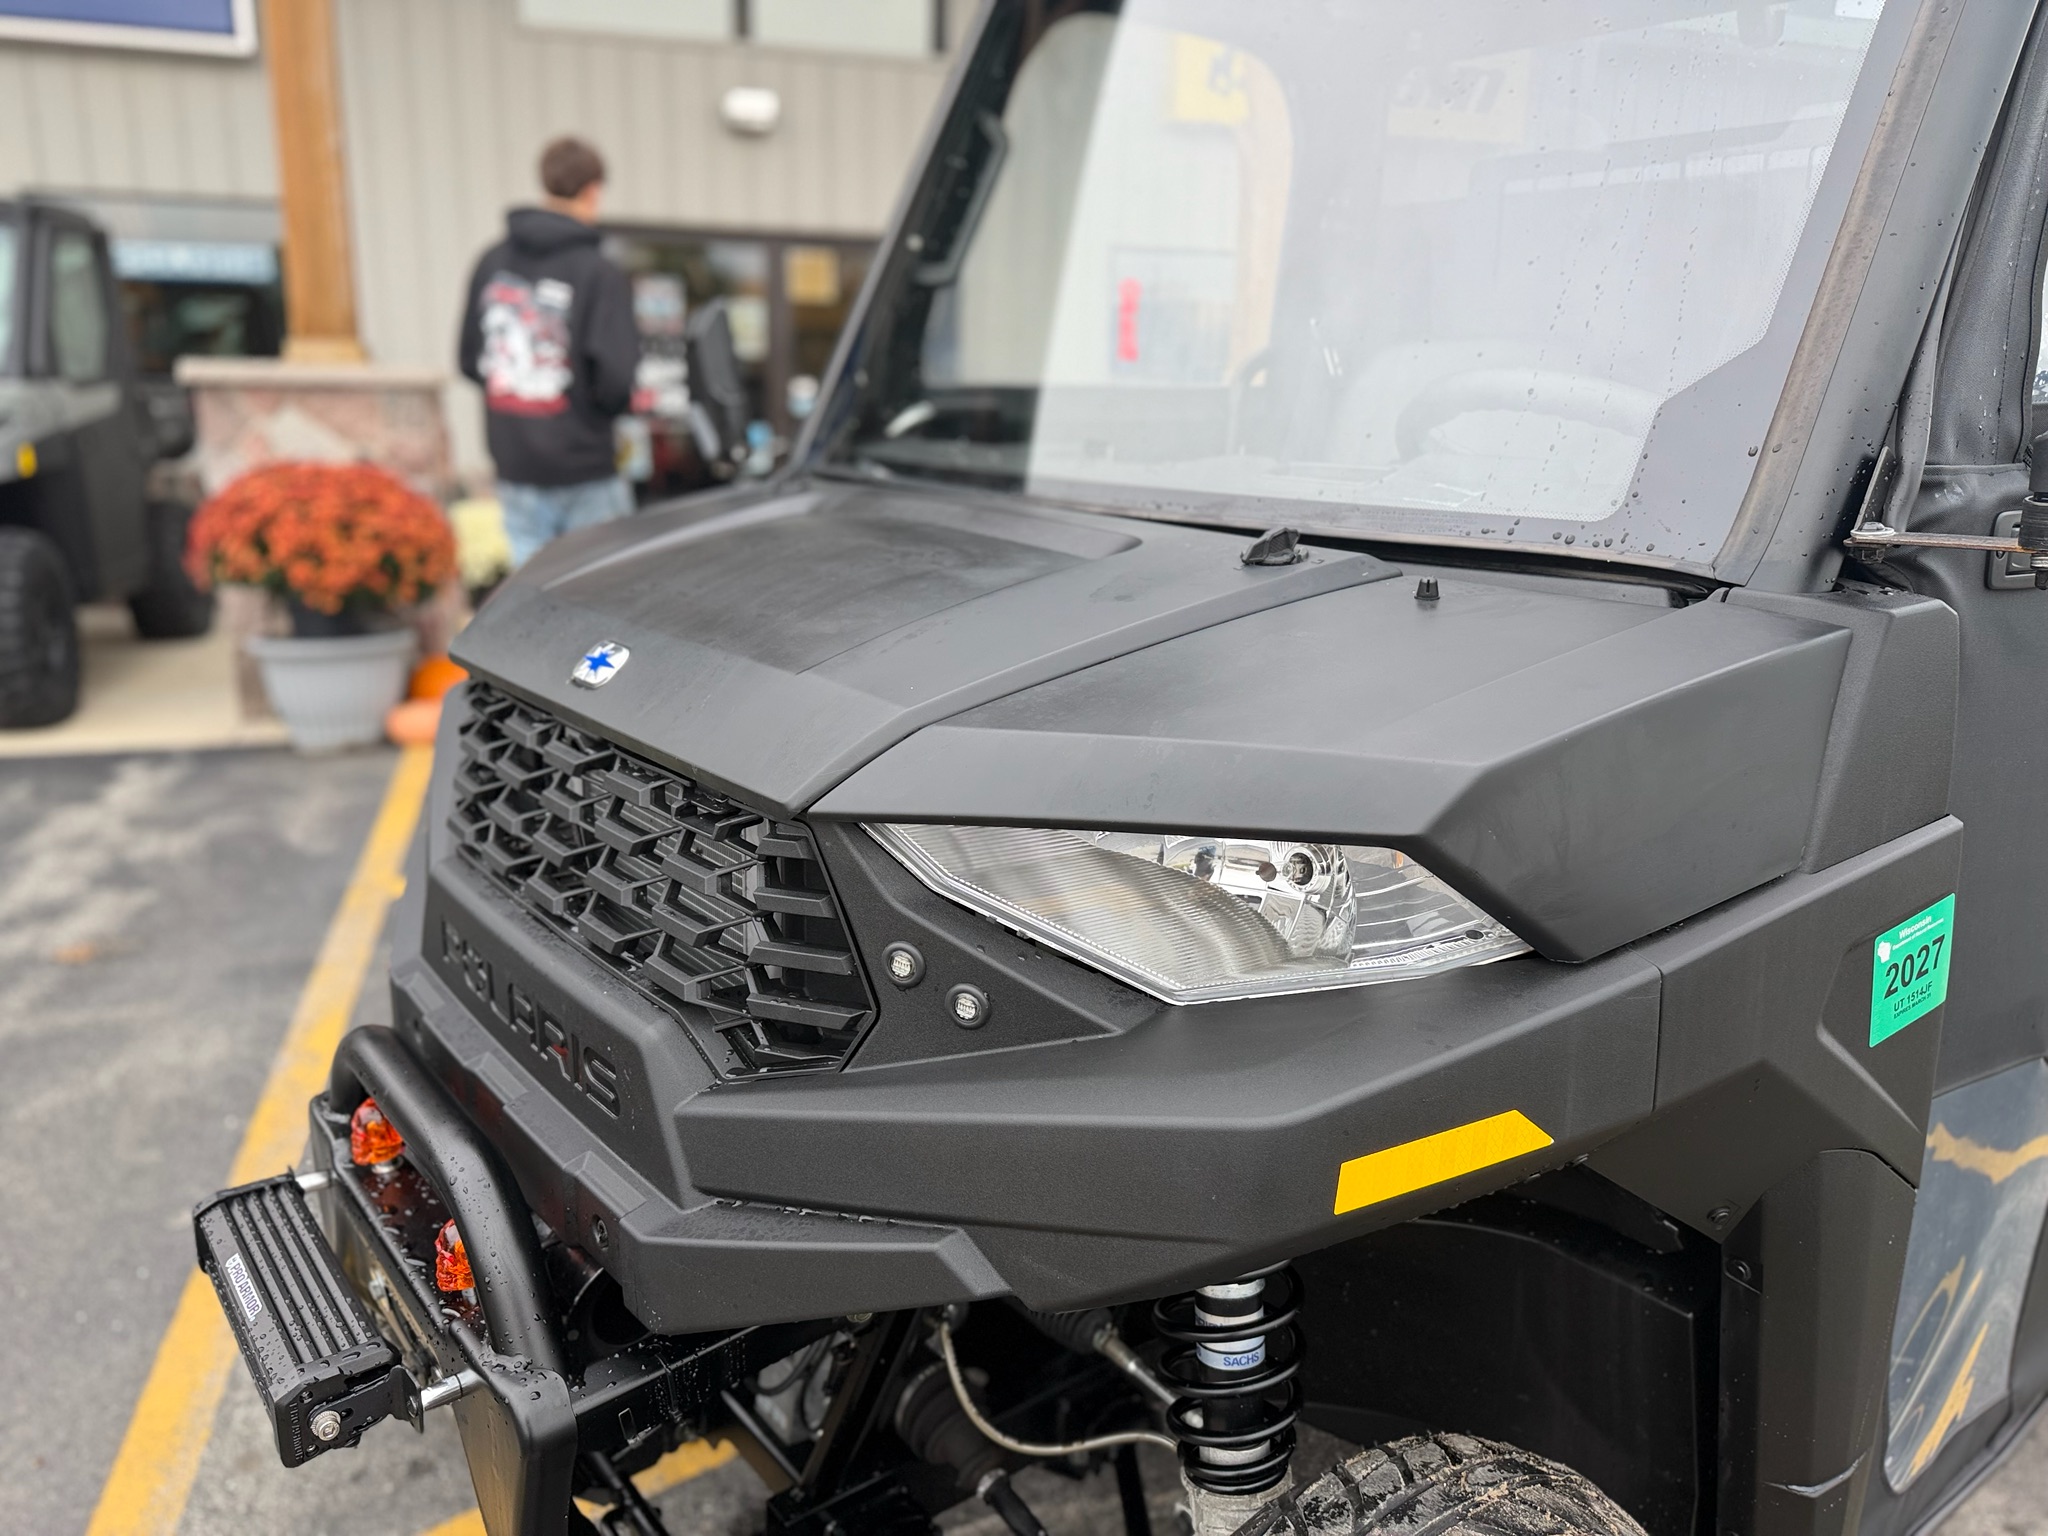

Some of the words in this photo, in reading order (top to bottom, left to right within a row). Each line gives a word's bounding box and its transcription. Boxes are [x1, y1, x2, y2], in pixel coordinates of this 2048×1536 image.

[1898, 915, 1932, 939] Wisconsin
[1883, 933, 1946, 1000] 2027
[1893, 997, 1906, 1012] UT
[441, 916, 621, 1120] POLARIS
[230, 1262, 246, 1284] PRO
[237, 1280, 260, 1316] ARMOR
[1223, 1351, 1260, 1367] SACHS
